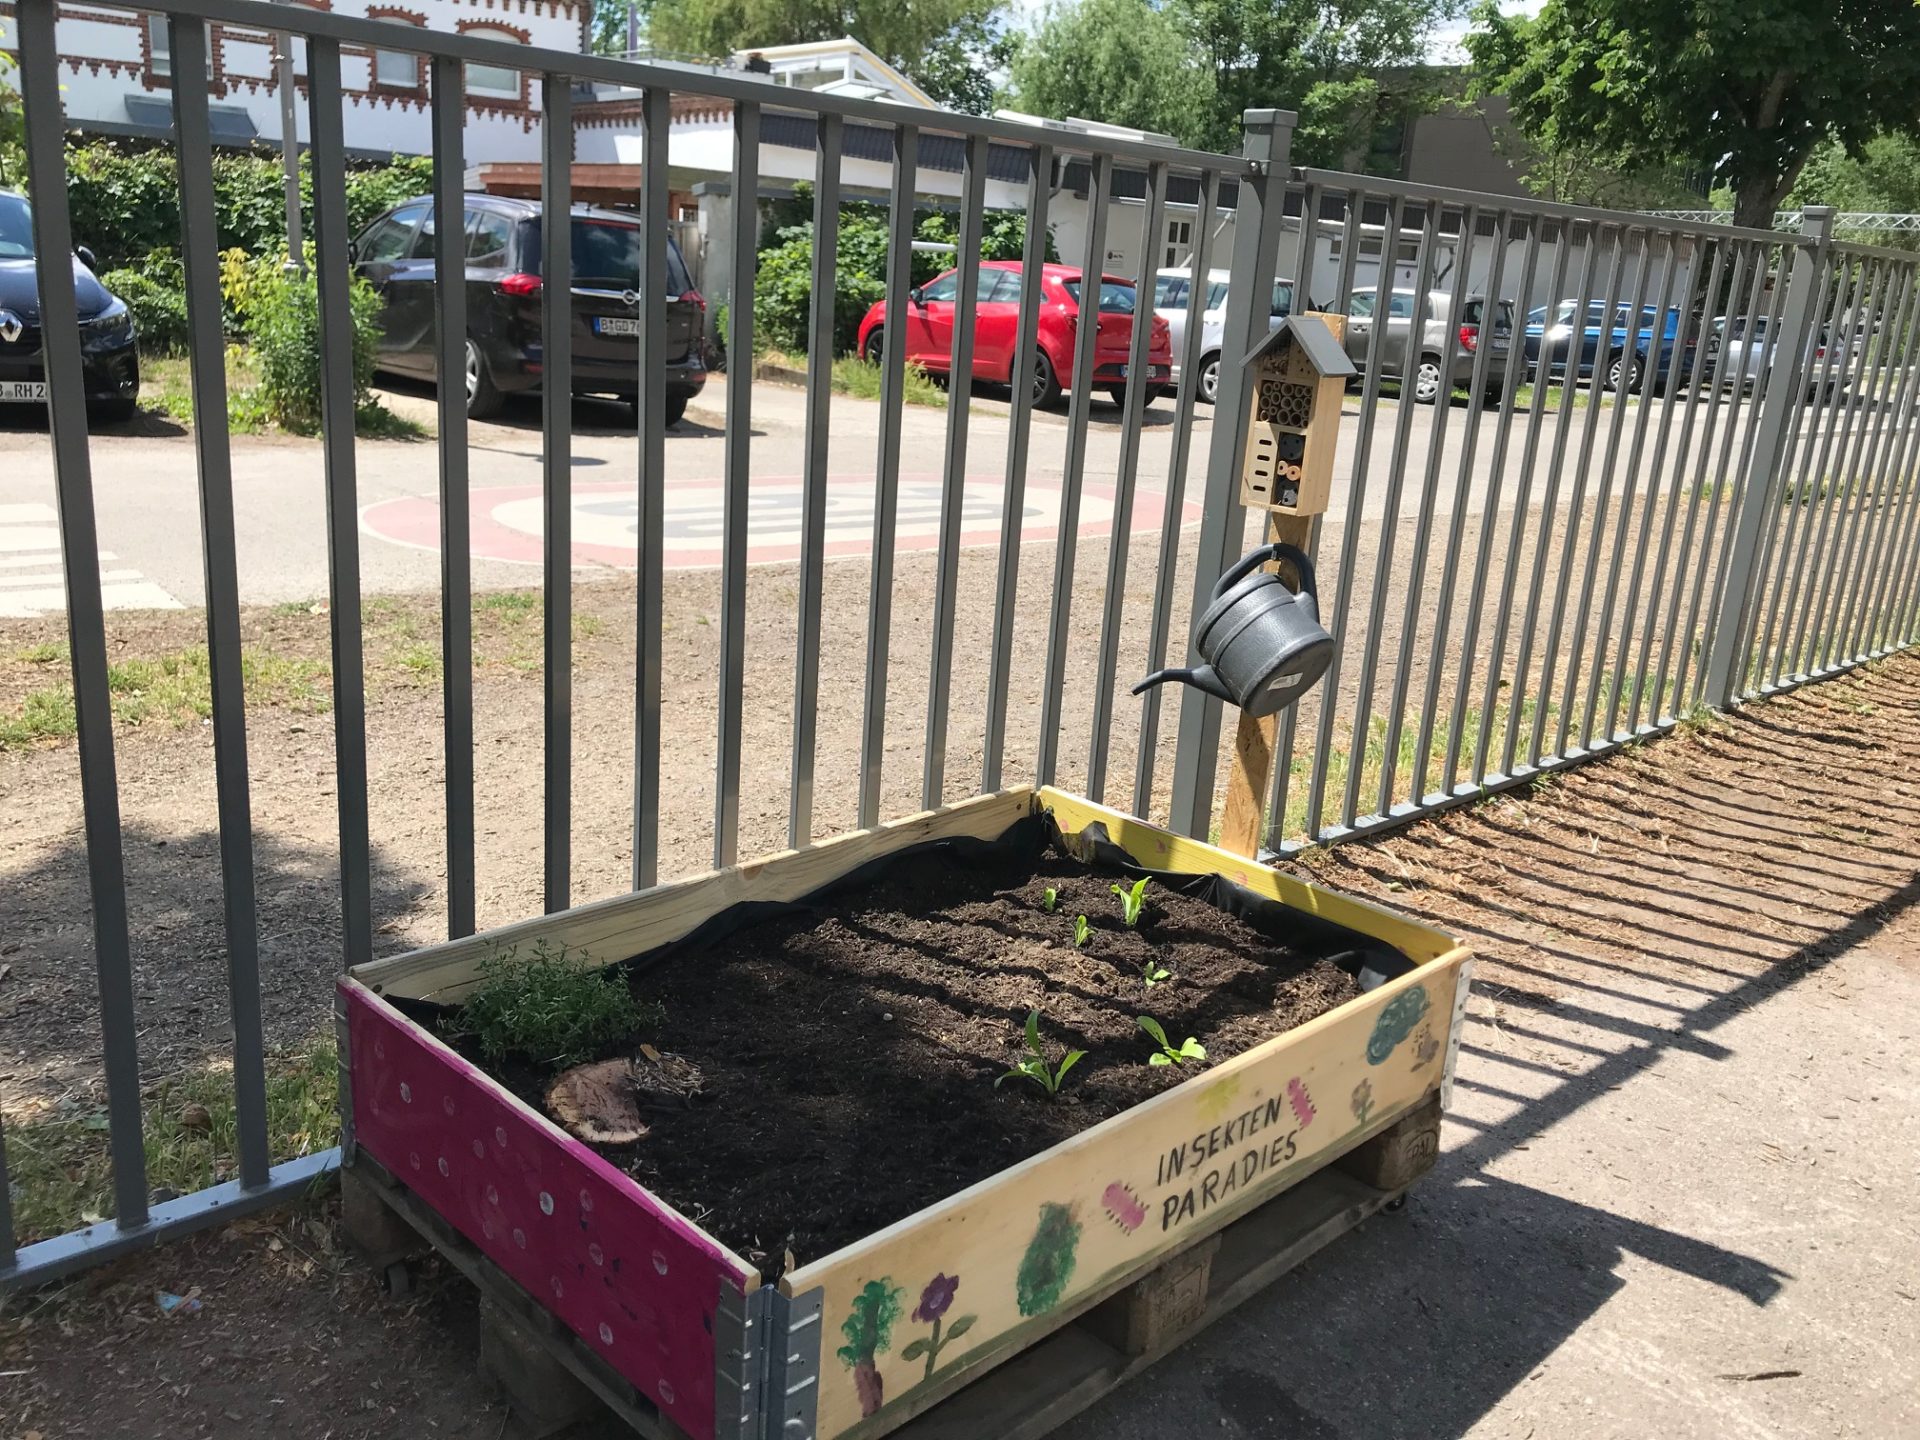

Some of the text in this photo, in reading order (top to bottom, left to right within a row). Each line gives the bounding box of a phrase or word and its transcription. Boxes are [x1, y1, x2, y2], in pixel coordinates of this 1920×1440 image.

[14, 383, 33, 398] RH
[1157, 1093, 1282, 1187] INSEKTEN
[1162, 1129, 1298, 1232] PARADIES
